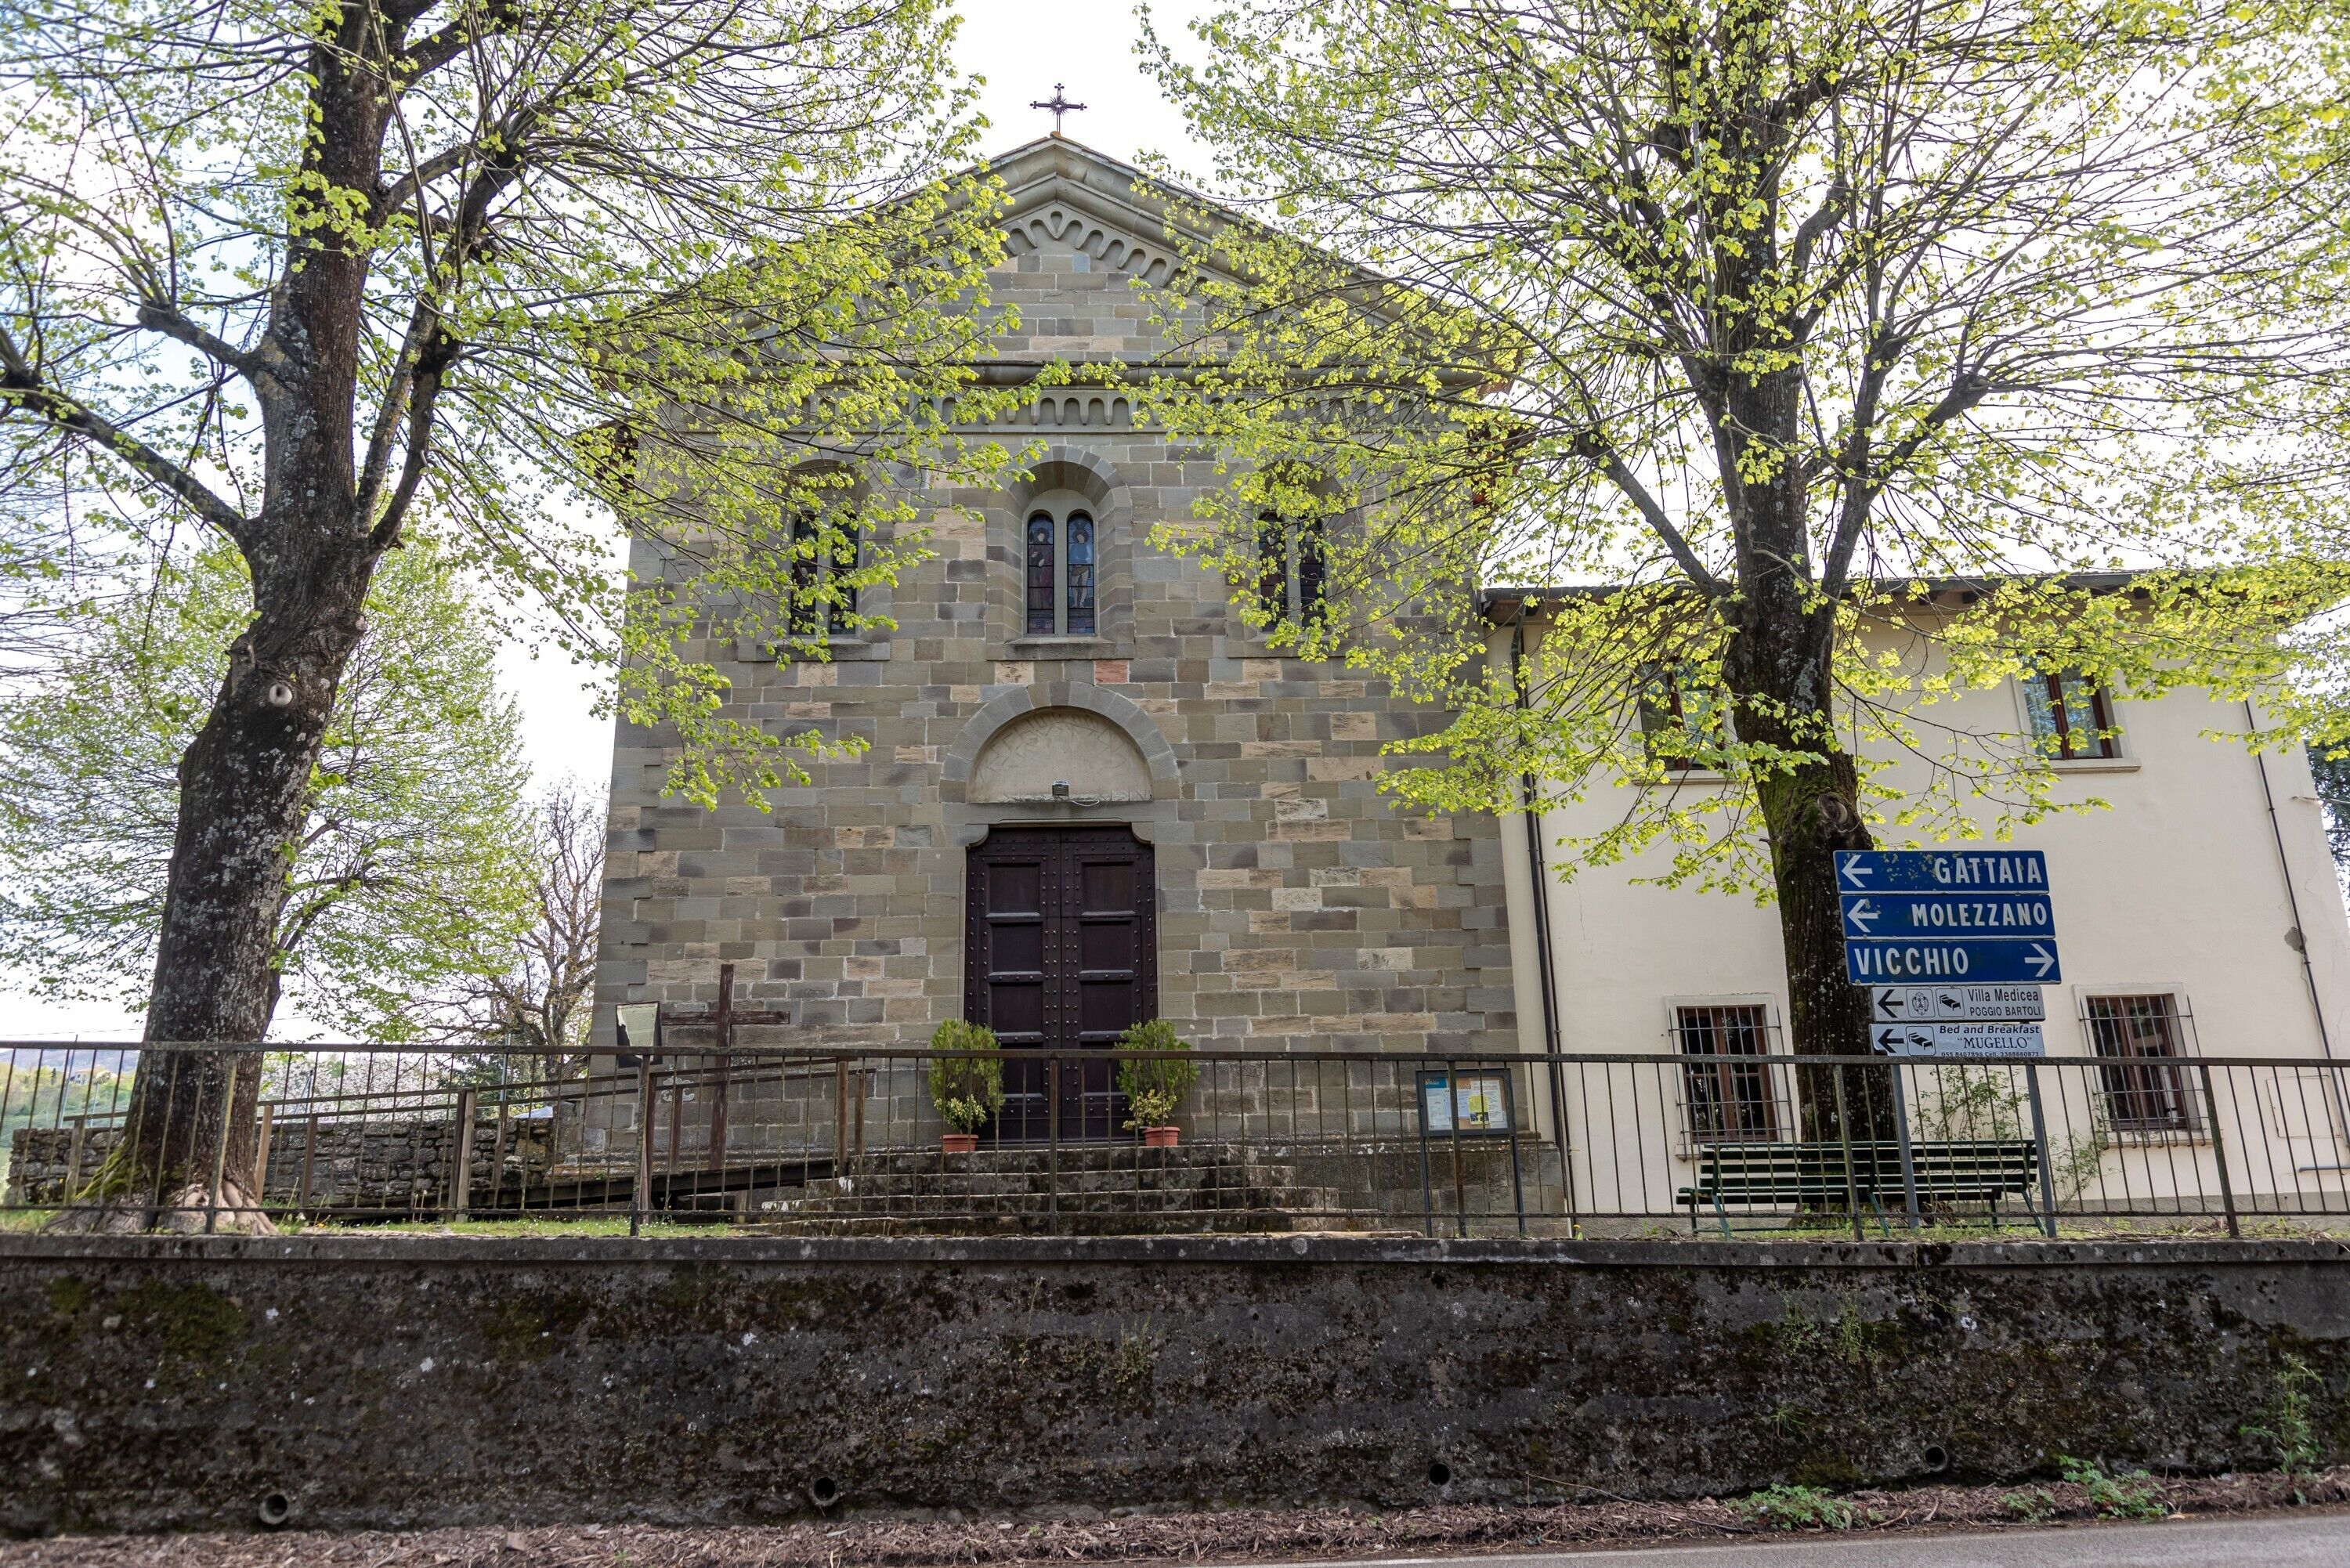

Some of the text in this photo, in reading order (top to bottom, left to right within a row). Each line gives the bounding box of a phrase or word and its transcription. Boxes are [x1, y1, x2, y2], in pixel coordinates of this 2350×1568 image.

[1934, 858, 2042, 883] GATTAIA
[1911, 902, 2047, 927] MOLEZZANO
[1854, 947, 1969, 975] VICCHIO
[1968, 988, 2038, 1002] Villa Medicea
[1969, 1006, 2041, 1016] POGGIO BARTOLI
[1940, 1025, 2040, 1034] Bed and Breakfast
